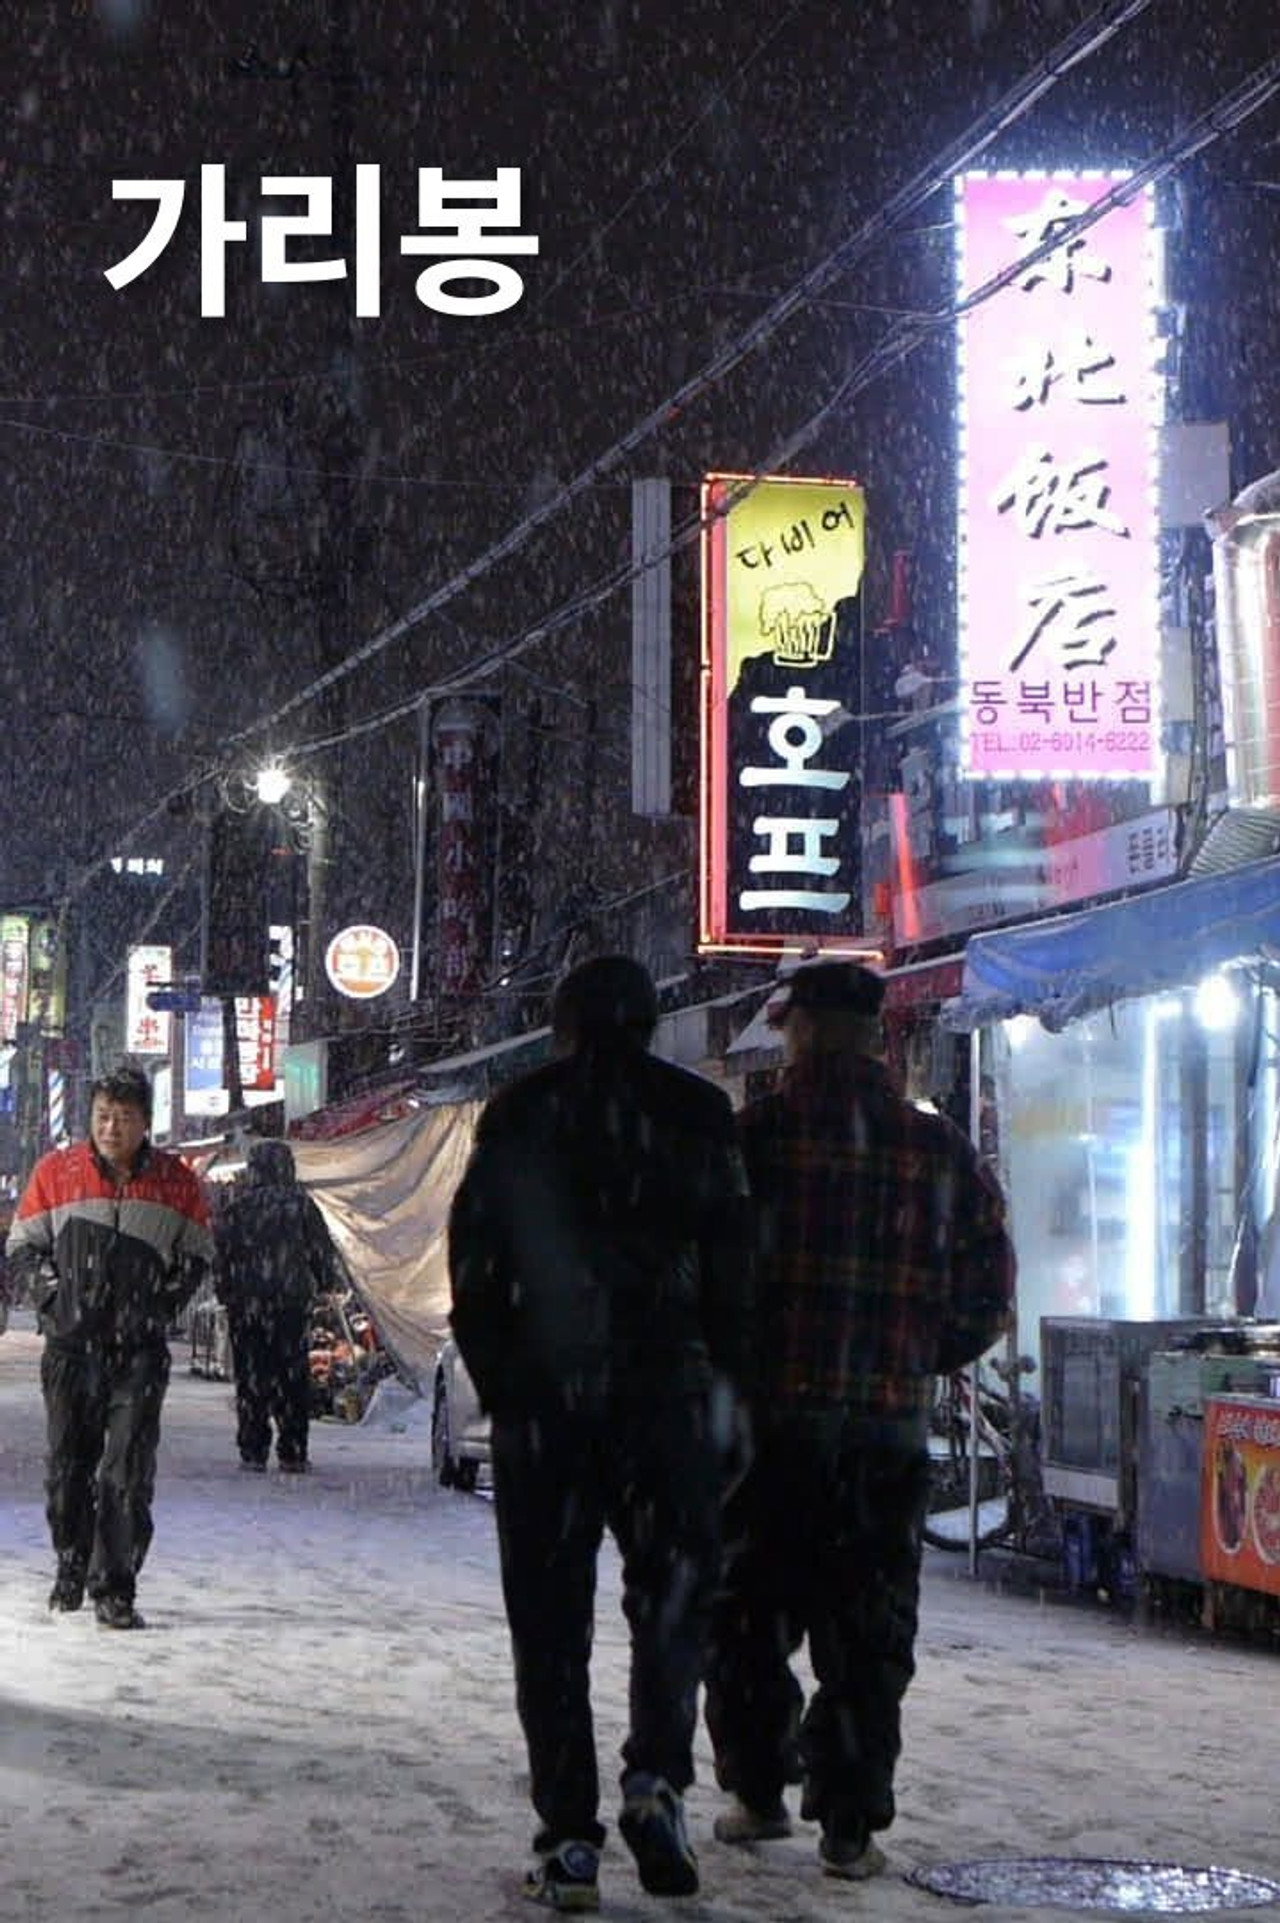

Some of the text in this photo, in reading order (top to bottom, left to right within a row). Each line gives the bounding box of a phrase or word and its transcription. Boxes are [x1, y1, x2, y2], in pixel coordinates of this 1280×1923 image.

[734, 501, 855, 569] 다비어
[969, 680, 1151, 725] 동북반점
[739, 686, 851, 912] 호프
